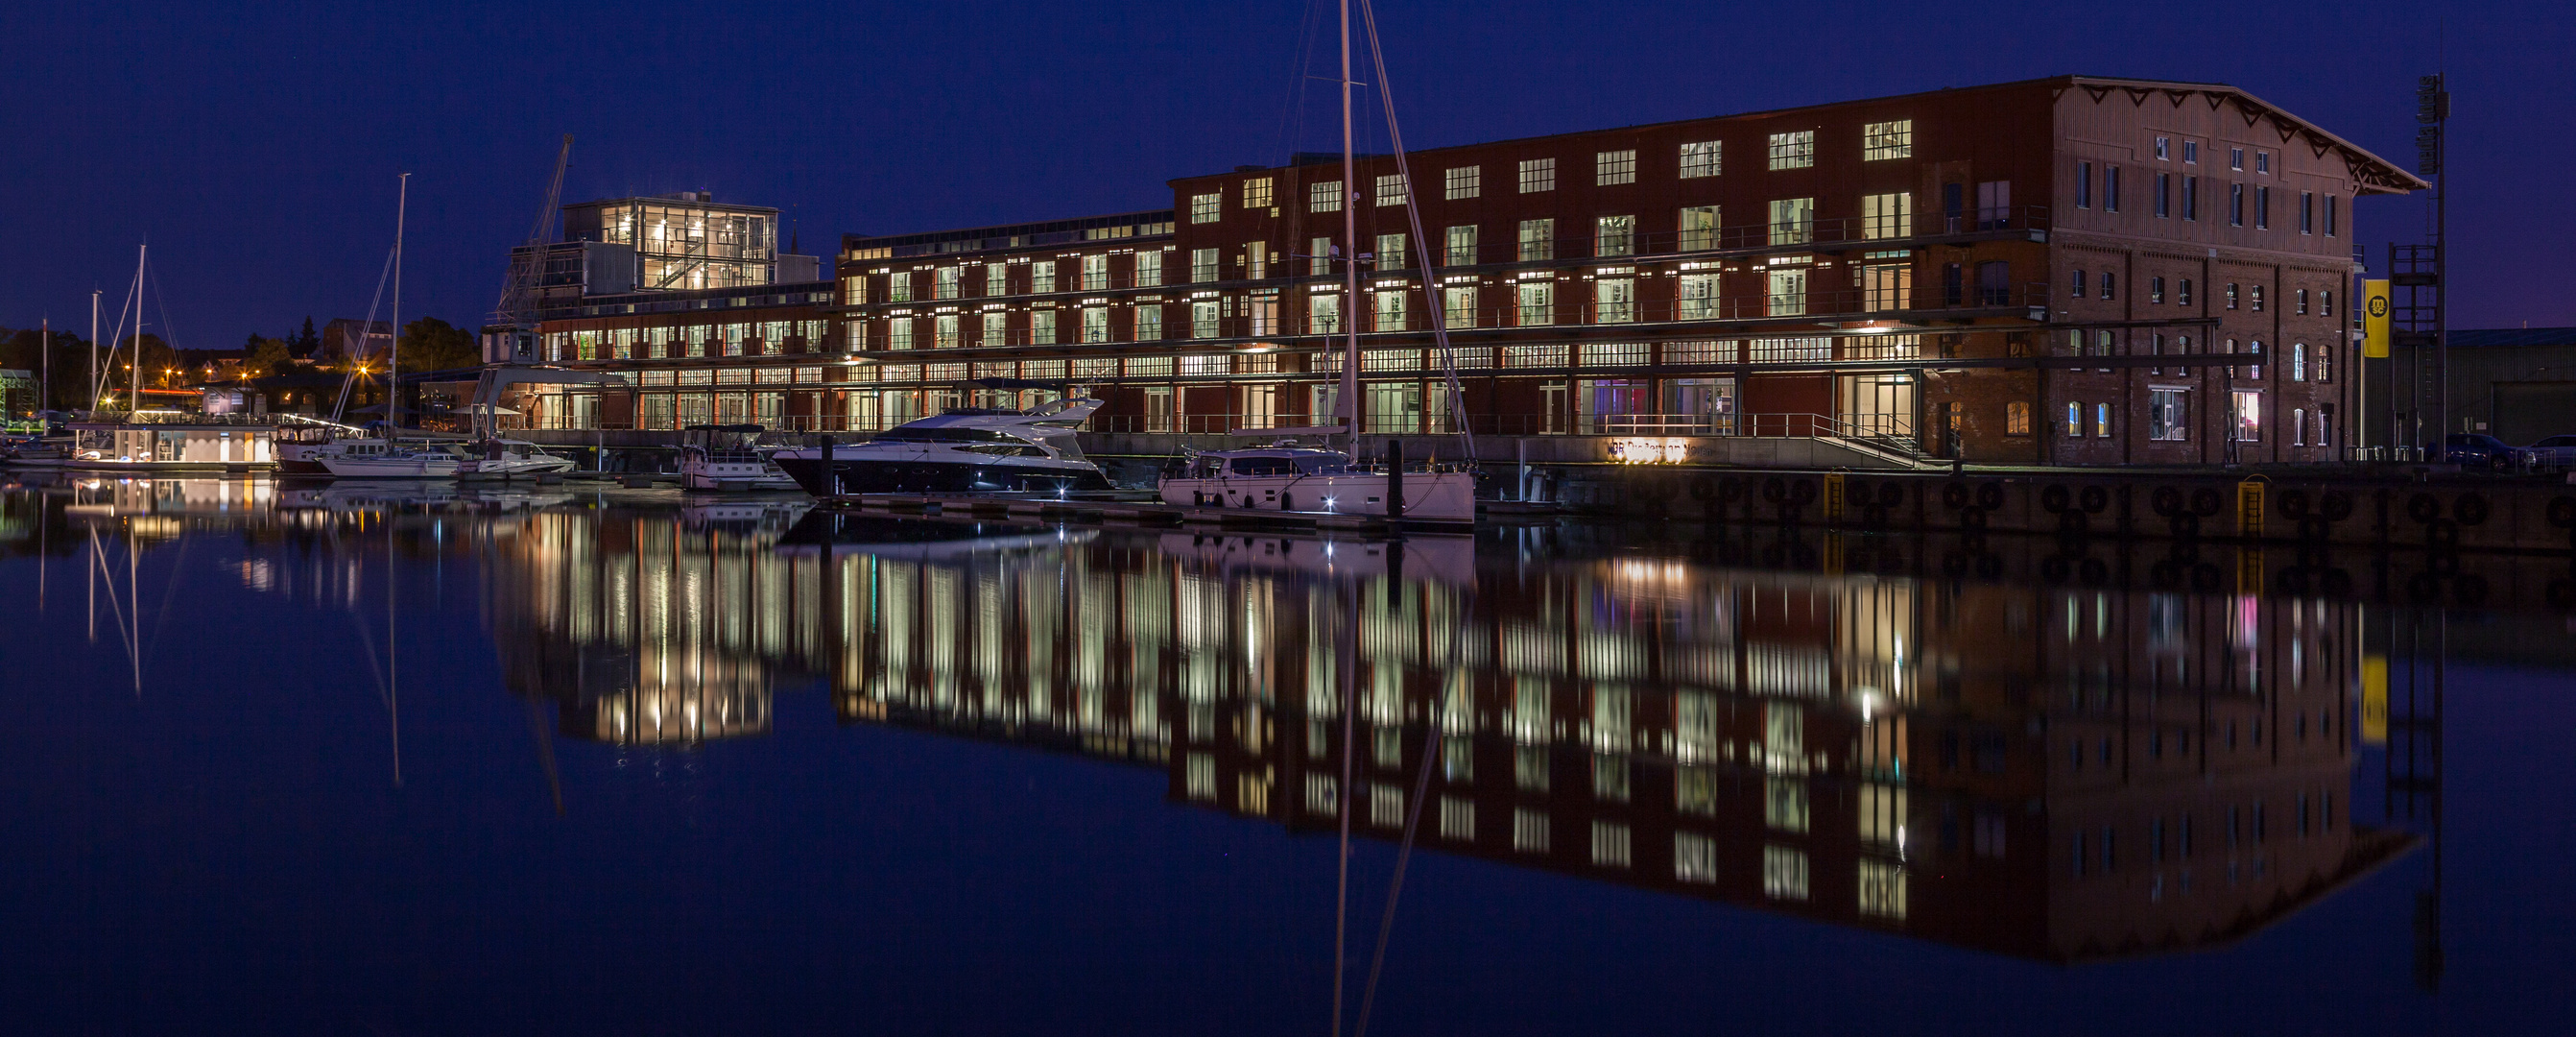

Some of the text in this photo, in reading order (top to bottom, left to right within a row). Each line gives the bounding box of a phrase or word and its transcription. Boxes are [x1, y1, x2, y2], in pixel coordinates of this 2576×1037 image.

[2416, 76, 2436, 175] media docks
[1683, 444, 1713, 456] Noden
